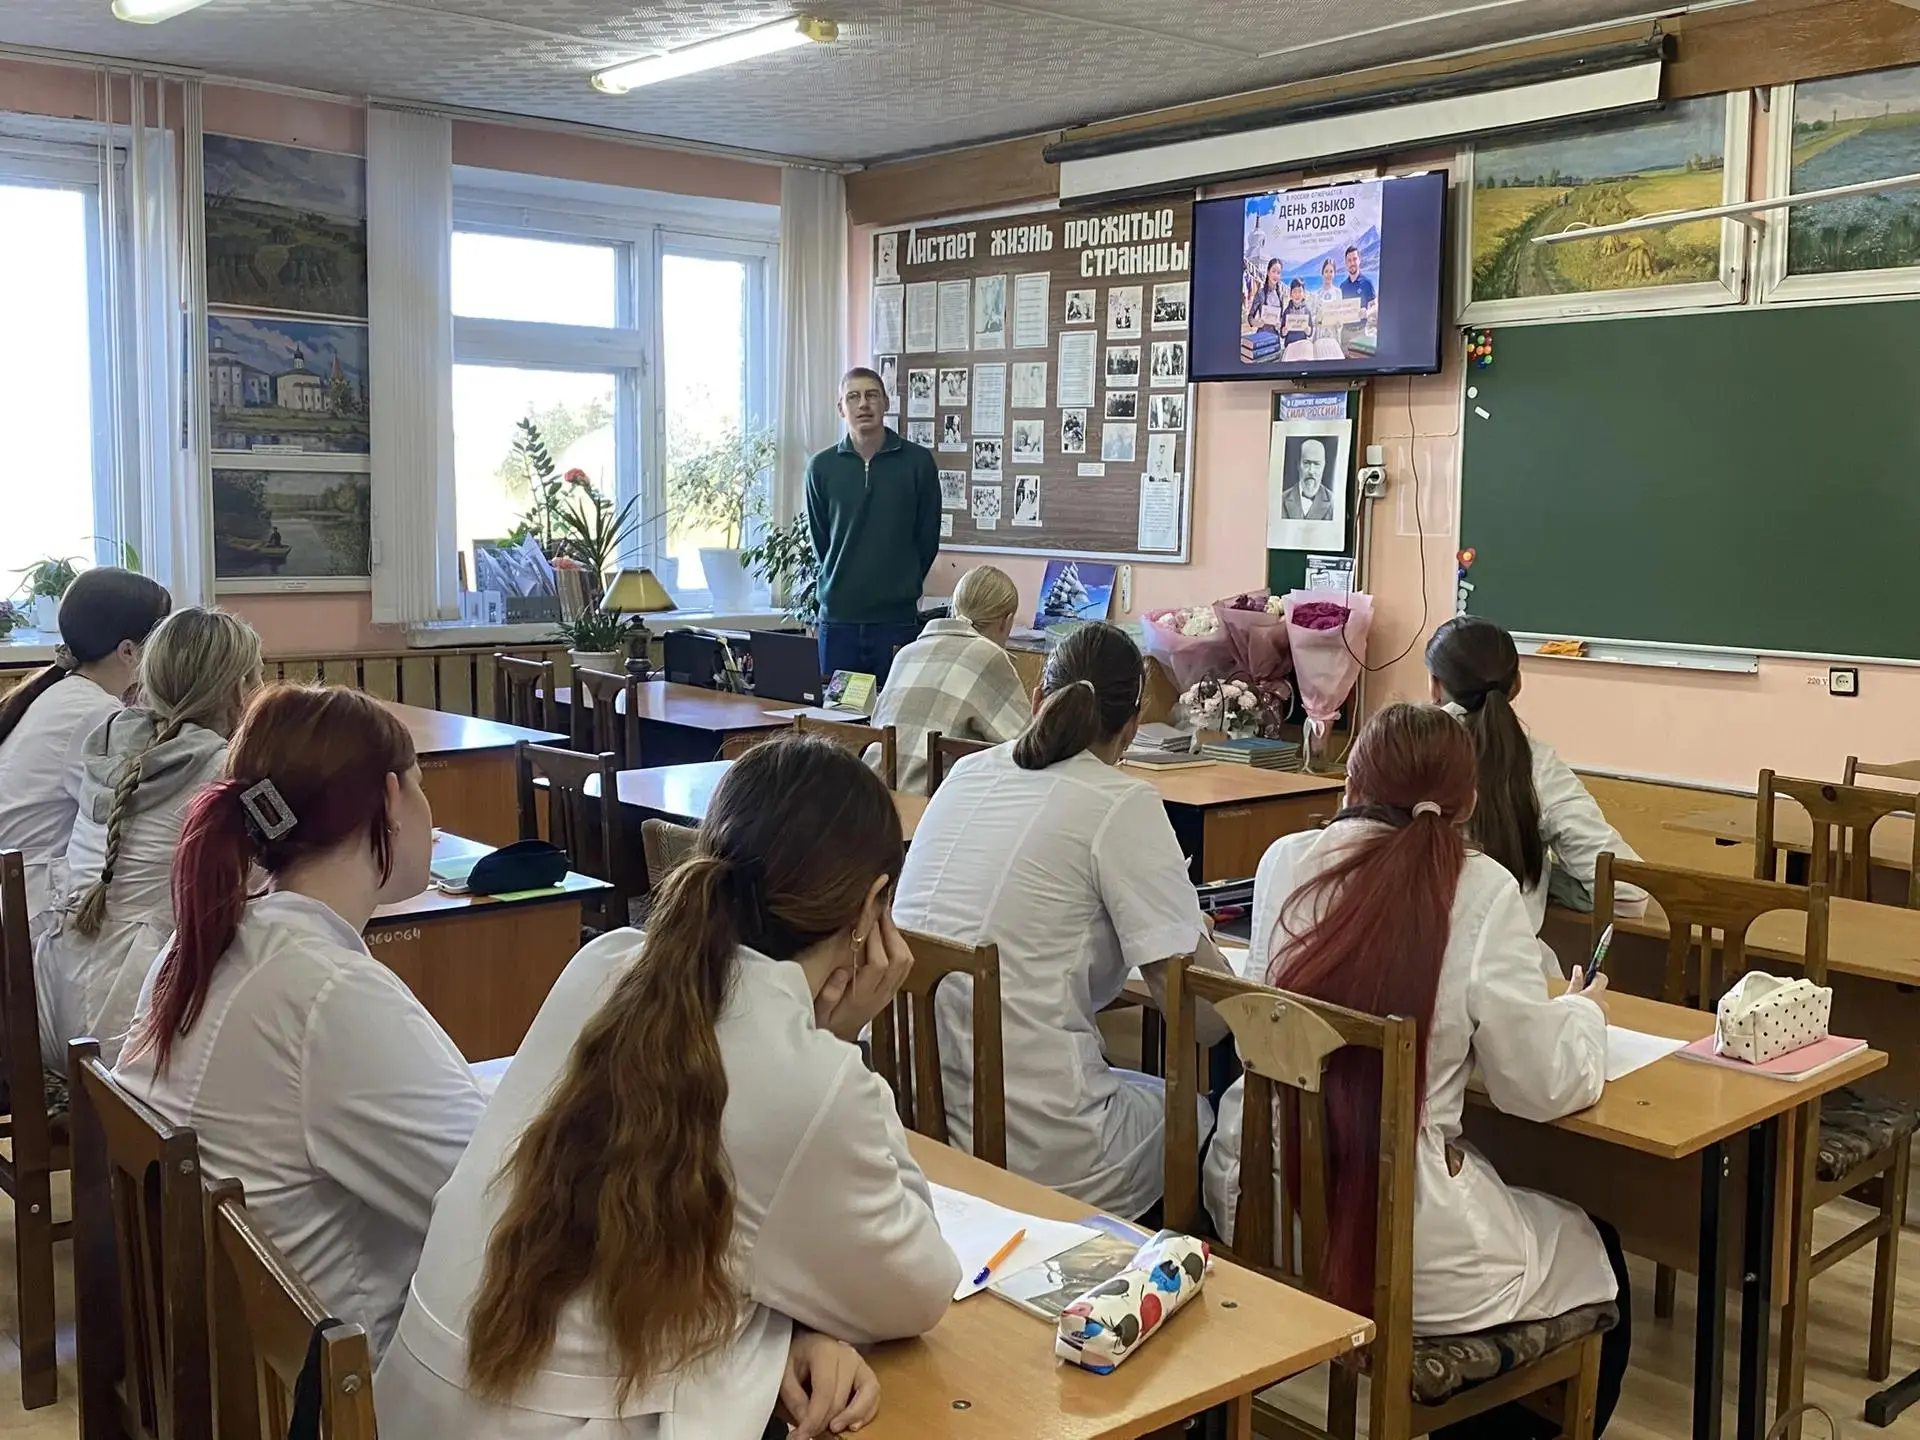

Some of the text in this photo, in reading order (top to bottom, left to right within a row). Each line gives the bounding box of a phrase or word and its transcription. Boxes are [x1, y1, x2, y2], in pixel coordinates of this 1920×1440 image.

[1279, 197, 1355, 219] ДЕНЬ ЯЗЫКОВ
[1287, 213, 1346, 232] НАРОДОВ
[906, 228, 977, 265] Листает
[990, 224, 1053, 257] жизнь
[1286, 405, 1340, 419] СИЛА РОССИИ!
[1807, 677, 1829, 686] 220 V
